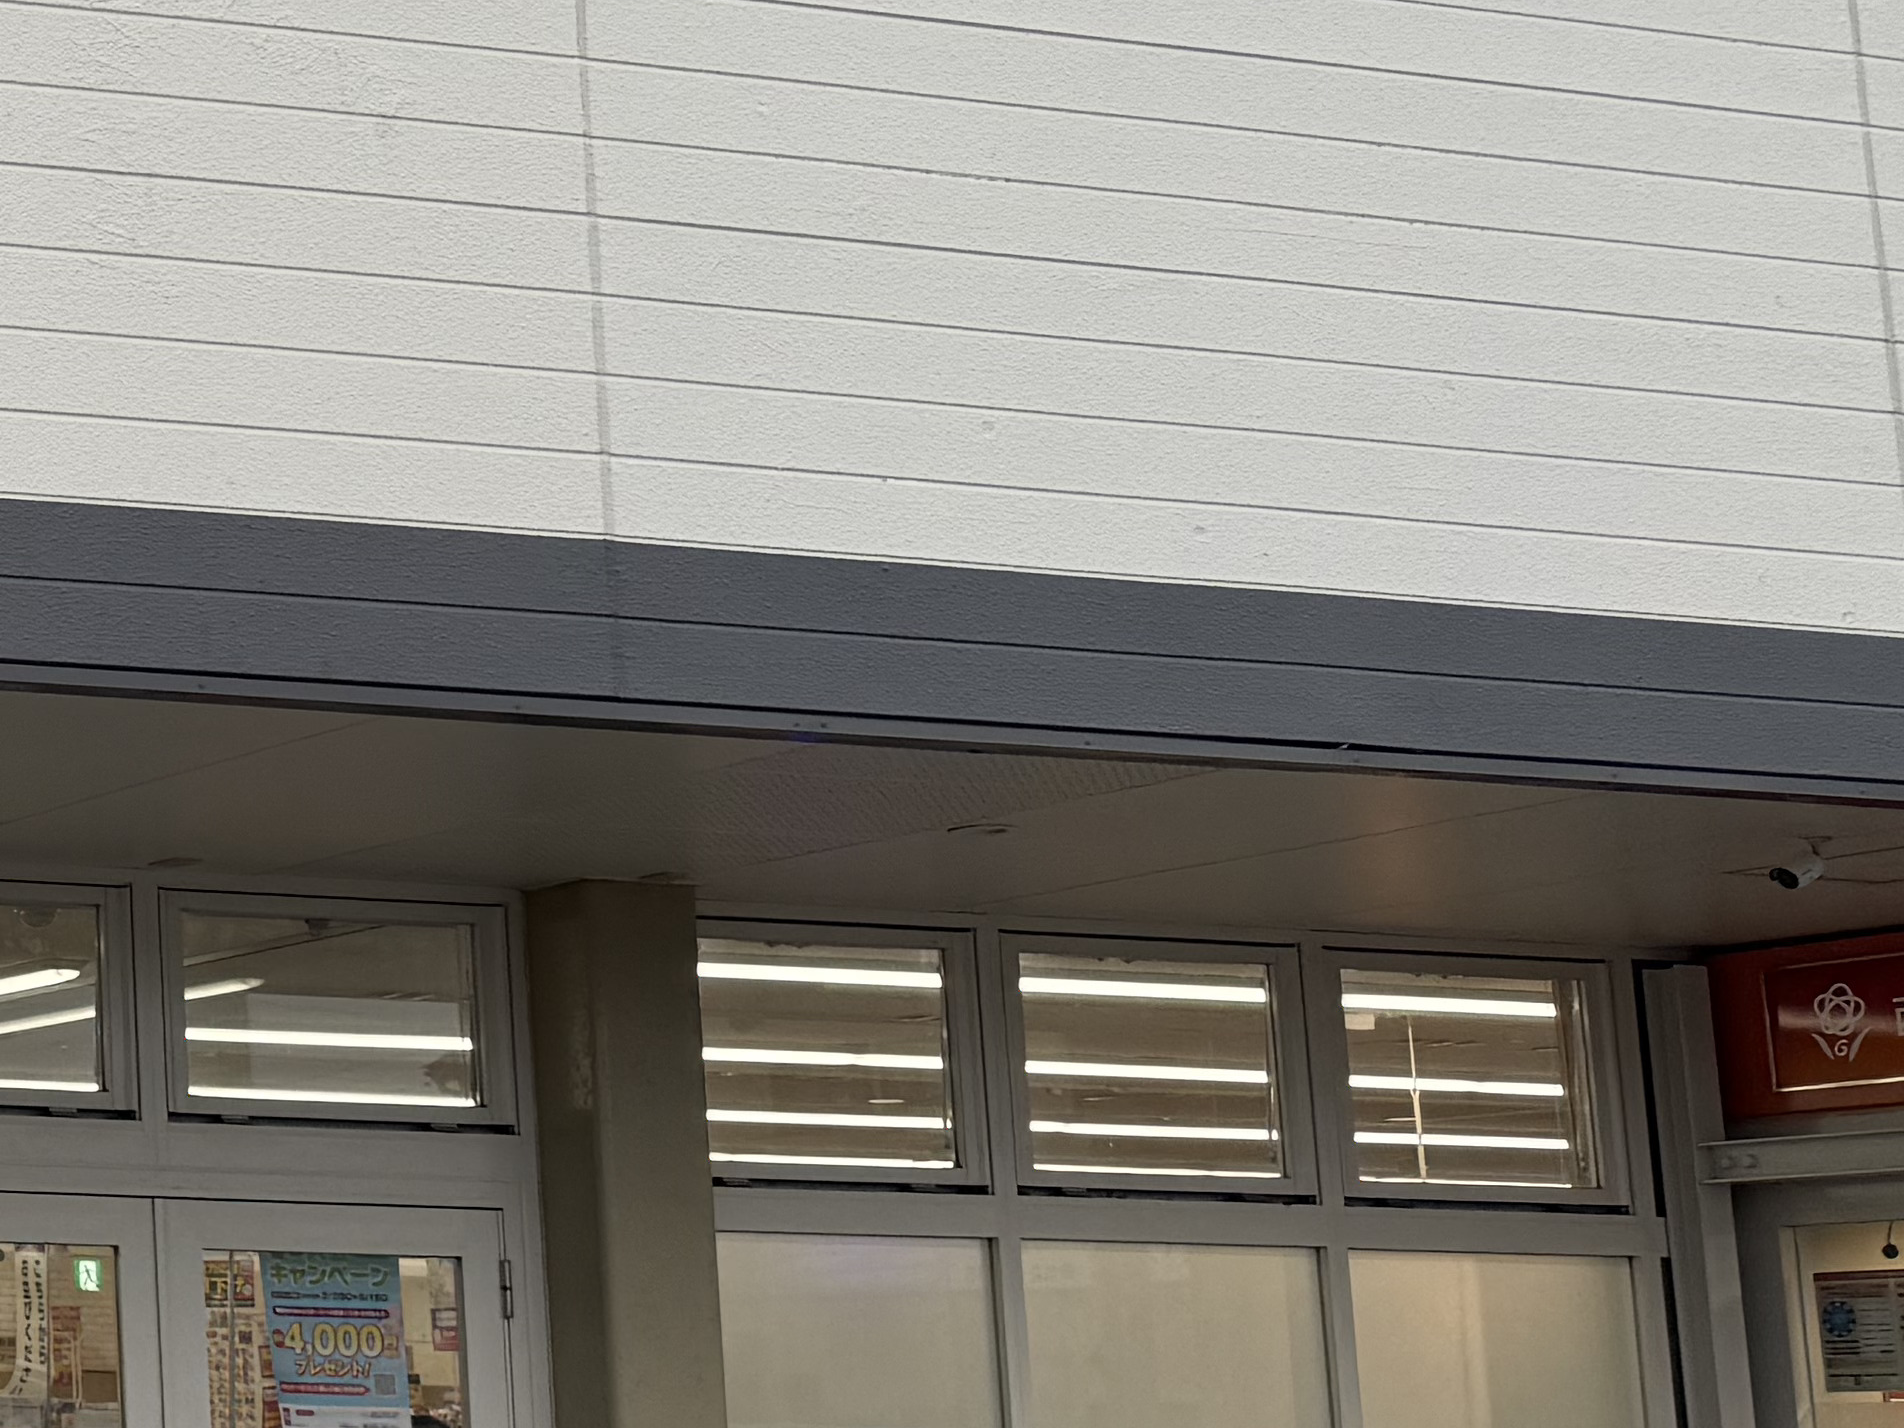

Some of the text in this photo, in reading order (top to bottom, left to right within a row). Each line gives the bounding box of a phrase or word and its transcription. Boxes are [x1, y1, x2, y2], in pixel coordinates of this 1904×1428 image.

[270, 1261, 390, 1287] キャンペーン
